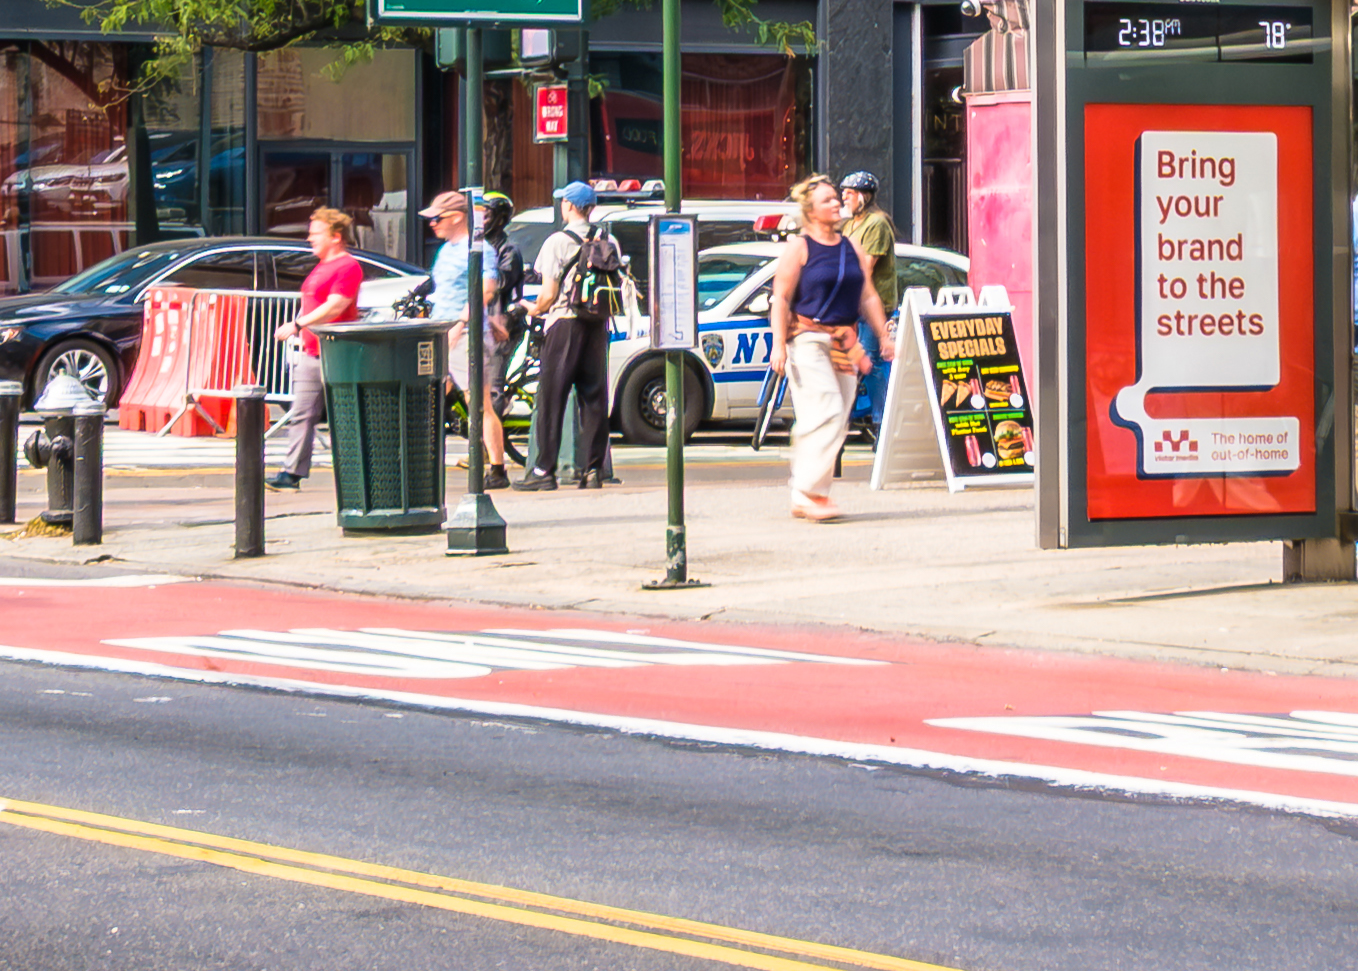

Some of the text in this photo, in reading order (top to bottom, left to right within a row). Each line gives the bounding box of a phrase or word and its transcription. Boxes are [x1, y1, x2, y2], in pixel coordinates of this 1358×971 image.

[1157, 149, 1236, 186] Bring
[1156, 195, 1224, 224] your
[1157, 233, 1243, 262] brand
[1157, 271, 1246, 300] to the
[930, 316, 1004, 341] EVERYDAY
[1157, 310, 1265, 336] streets
[732, 332, 773, 364] NY
[937, 336, 1007, 360] SPECIALS
[1211, 431, 1288, 445] The home of
[1211, 448, 1289, 461] out-of-home
